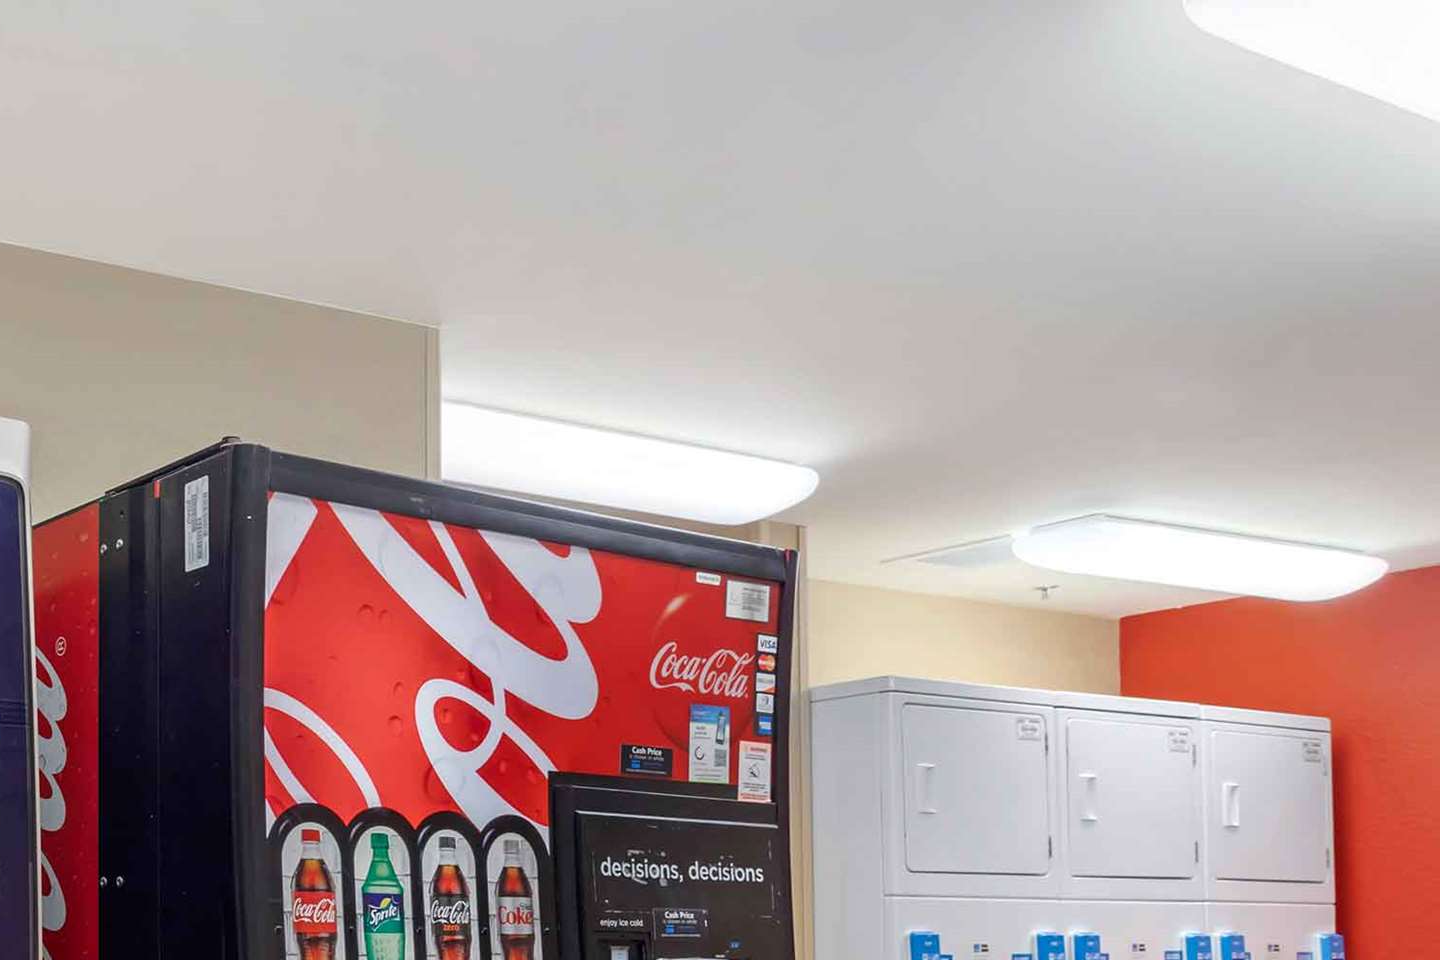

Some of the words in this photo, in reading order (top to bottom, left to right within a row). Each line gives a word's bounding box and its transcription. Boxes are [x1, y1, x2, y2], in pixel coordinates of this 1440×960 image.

[760, 639, 776, 649] VISA
[650, 641, 754, 698] Coca-Cola
[632, 746, 647, 754] Cash
[648, 748, 662, 756] Price
[600, 857, 684, 883] decisions,
[689, 861, 764, 882] decisions
[292, 897, 337, 924] Coca-Cola
[370, 906, 398, 931] Sprite
[431, 899, 470, 924] Coca-Cola
[498, 905, 533, 925] Coke
[665, 911, 679, 919] Cash
[680, 911, 694, 919] Price
[600, 919, 617, 927] enjoy
[619, 918, 629, 927] ice
[630, 919, 643, 927] cold
